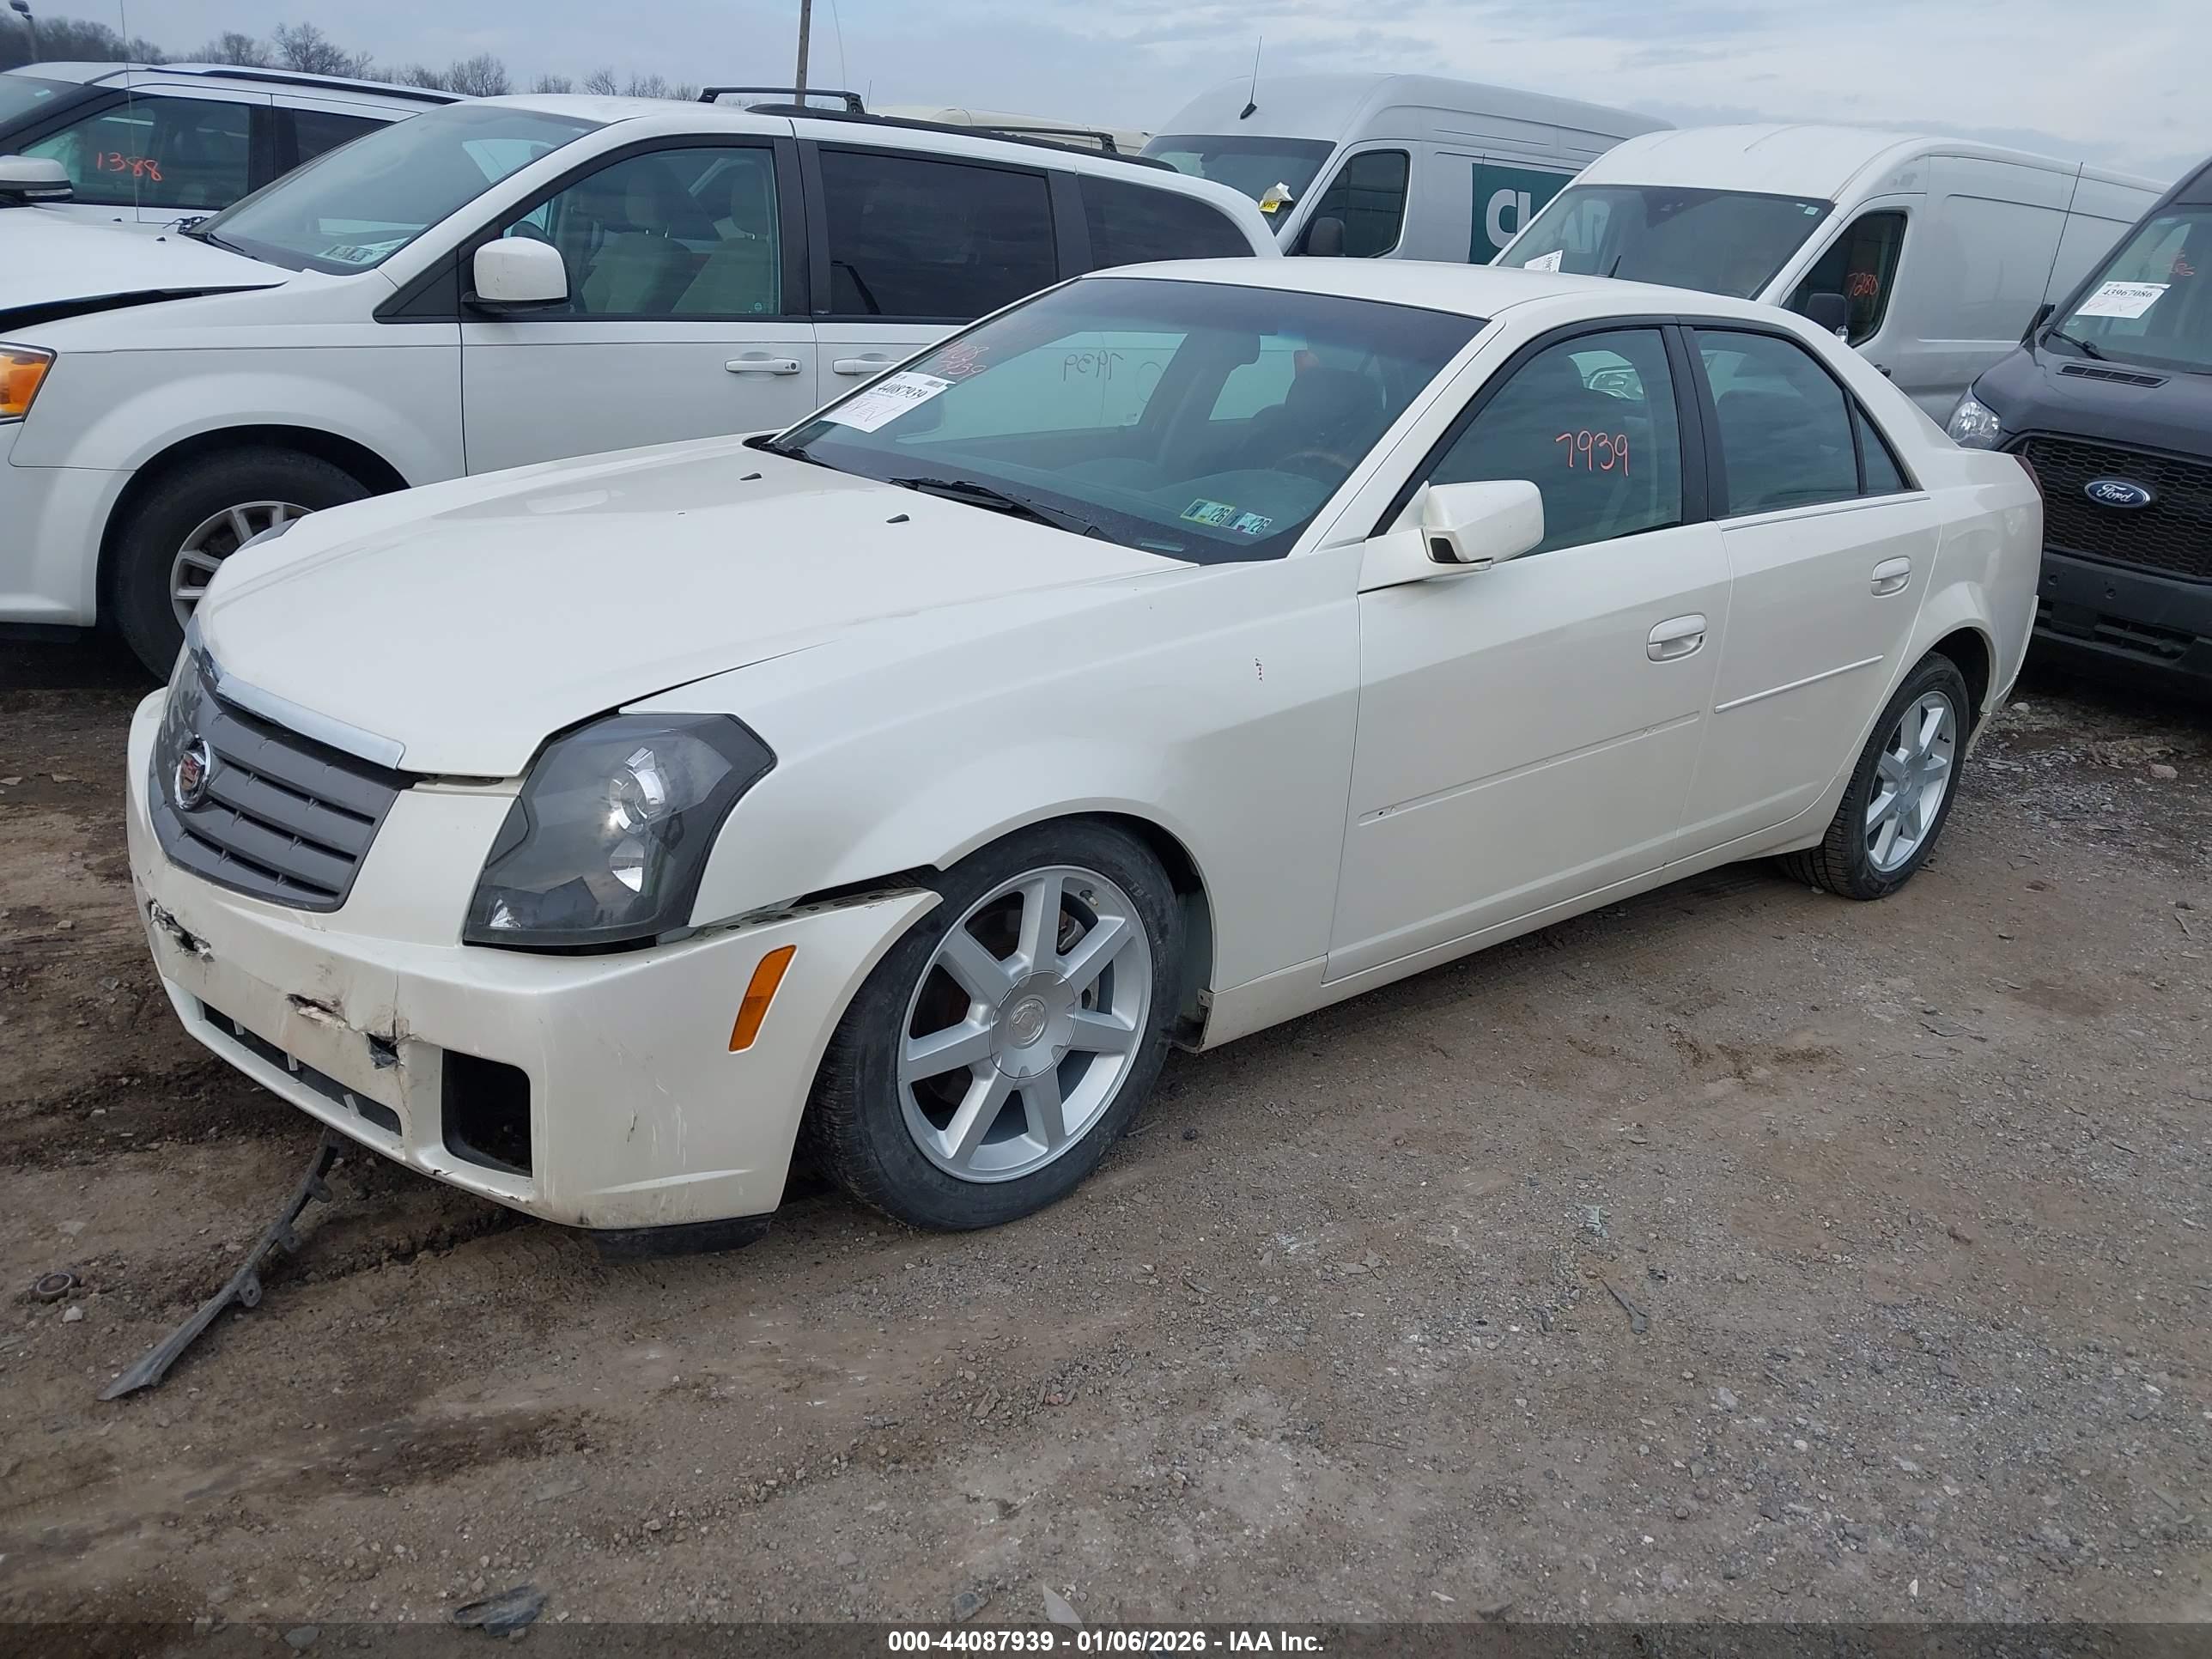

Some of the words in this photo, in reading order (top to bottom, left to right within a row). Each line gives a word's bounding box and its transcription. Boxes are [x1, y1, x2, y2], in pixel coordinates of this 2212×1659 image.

[96, 151, 163, 182] 1388
[1847, 272, 1879, 300] 7280
[1553, 430, 1630, 477] 7939
[2095, 483, 2135, 502] Ford
